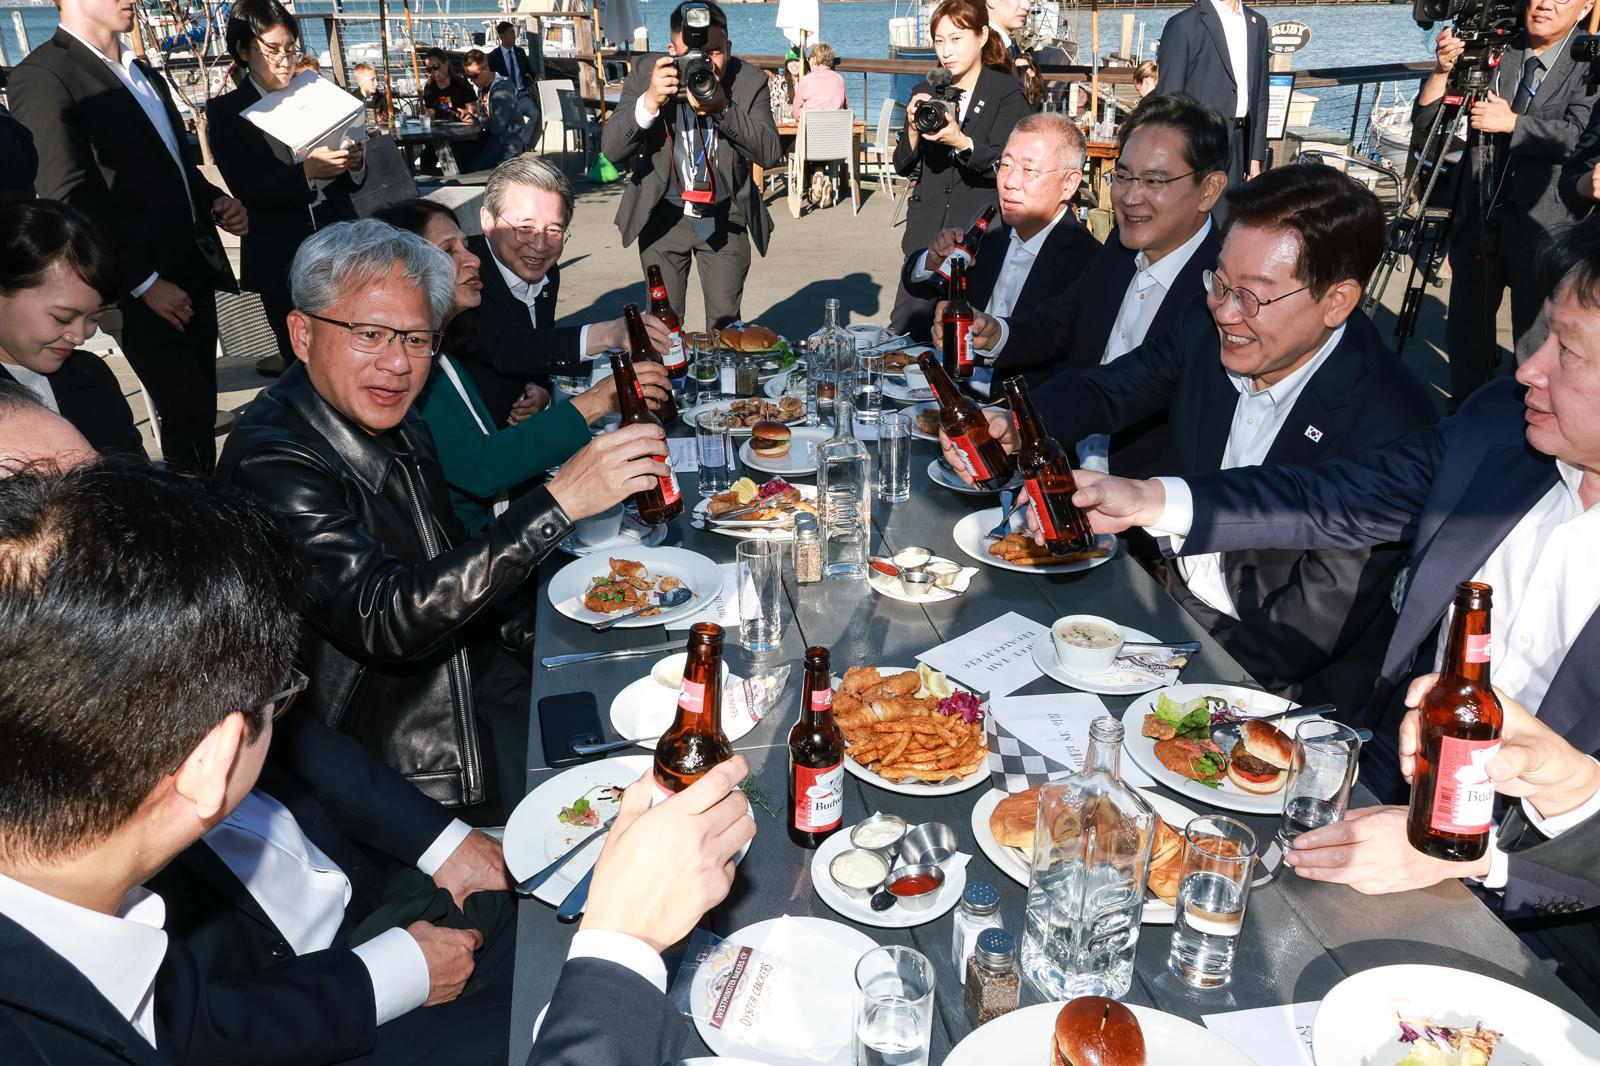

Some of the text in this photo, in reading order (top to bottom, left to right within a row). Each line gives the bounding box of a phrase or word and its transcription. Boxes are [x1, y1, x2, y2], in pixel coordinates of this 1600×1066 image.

[1271, 23, 1308, 37] RUBY
[715, 979, 737, 1019] WESTMINSTER
[740, 995, 758, 1027] OYSTER
[754, 962, 774, 996] CRACKERS
